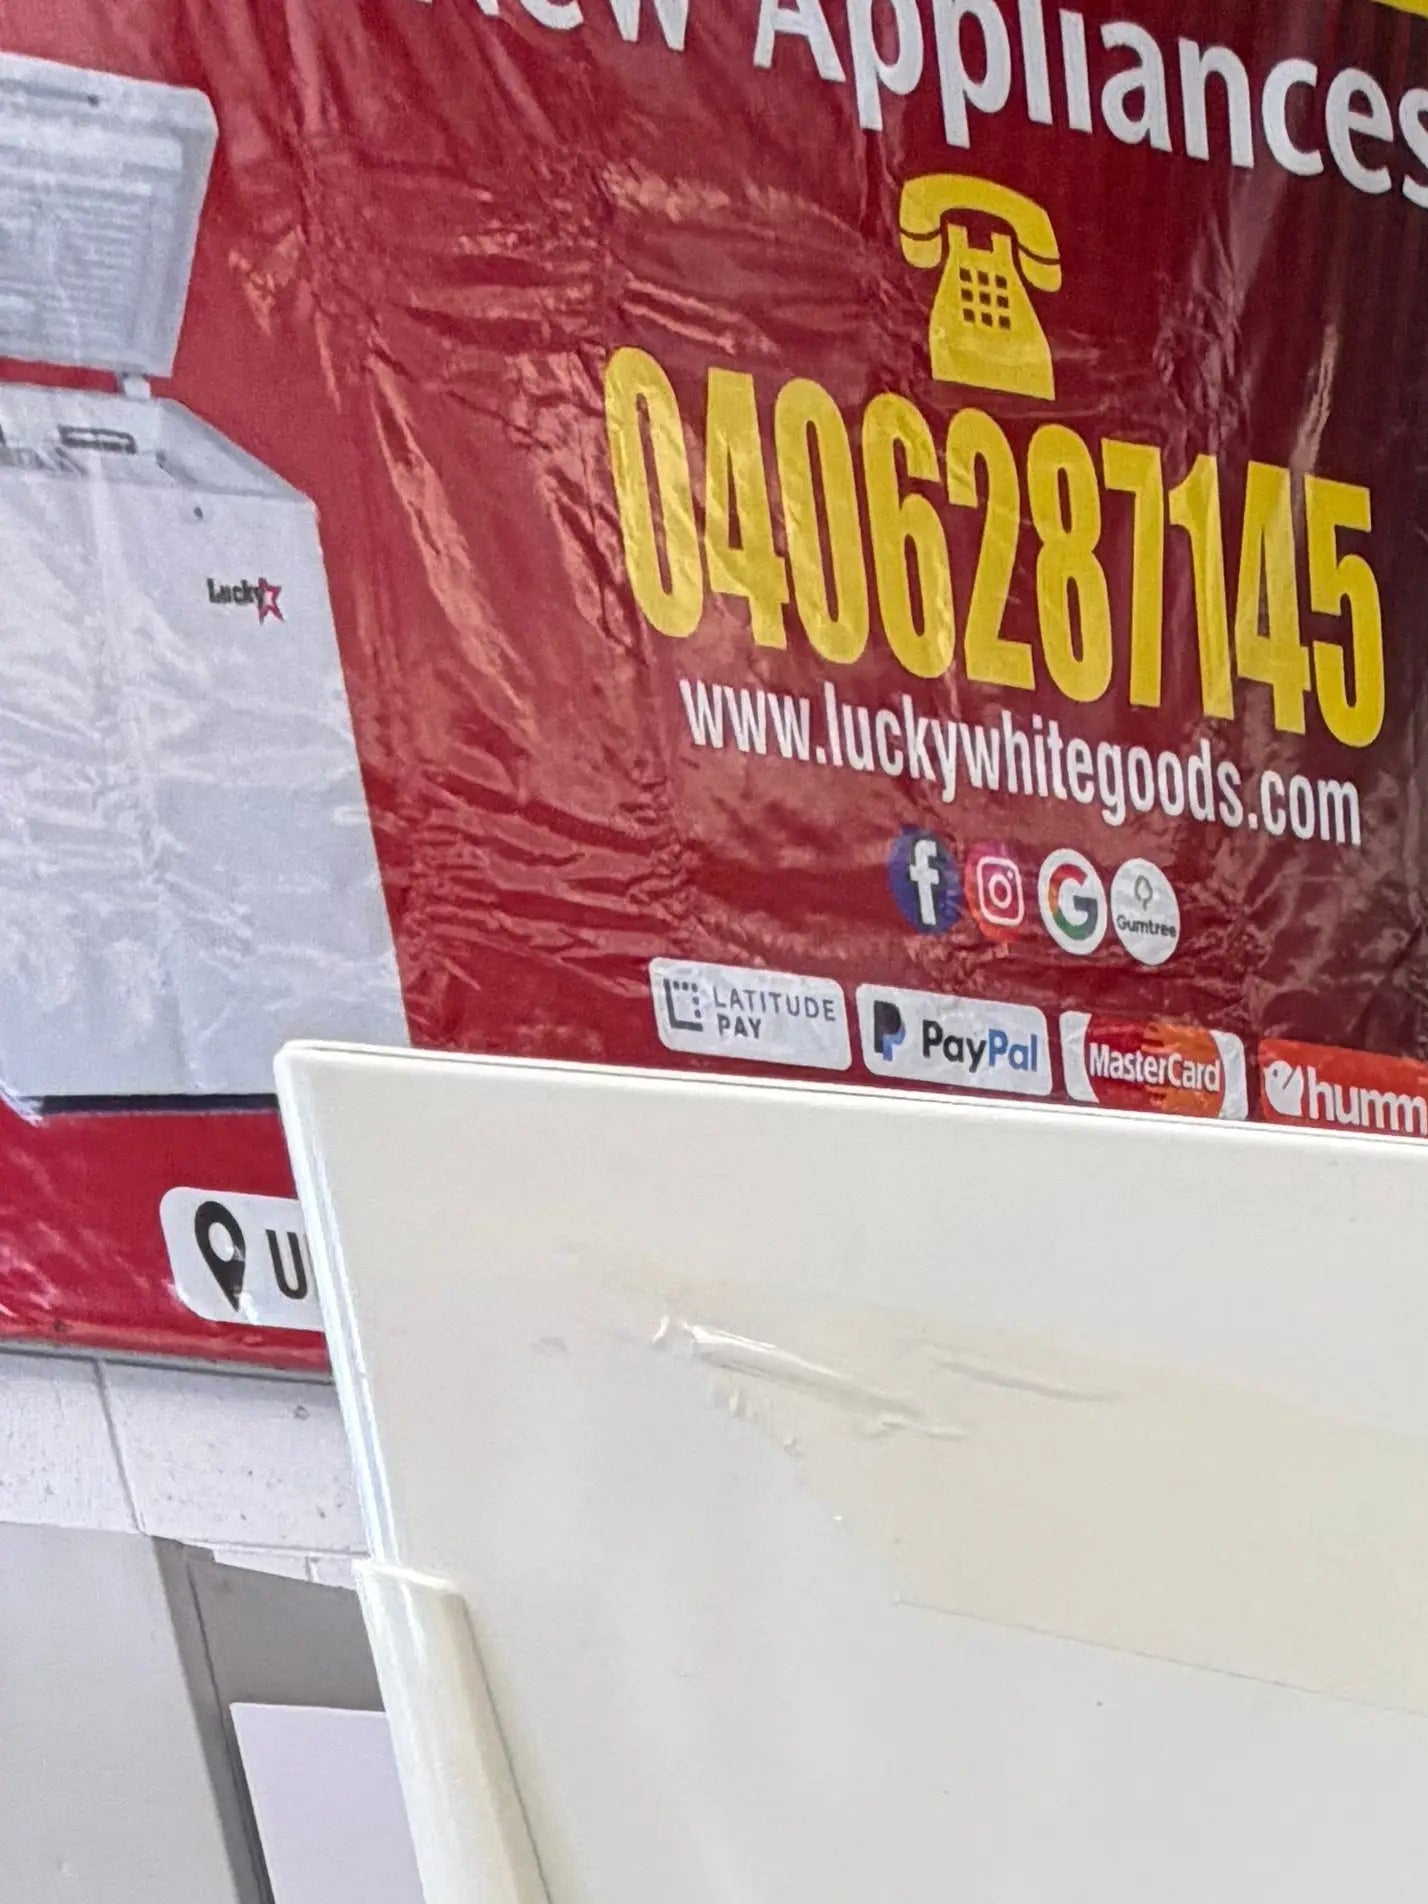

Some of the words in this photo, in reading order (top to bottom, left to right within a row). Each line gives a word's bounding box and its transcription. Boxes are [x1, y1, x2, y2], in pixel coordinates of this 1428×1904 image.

[604, 346, 1386, 748] 0406287145
[206, 577, 266, 617] Lucky
[680, 678, 1363, 847] www.luckywhitegoods.com
[1115, 911, 1178, 942] Gumtree
[713, 983, 838, 1025] LATITUDE
[715, 1014, 763, 1042] PAY
[921, 1018, 1039, 1074] PayPal
[1089, 1040, 1222, 1096] MasterCard
[1306, 1068, 1428, 1136] humm
